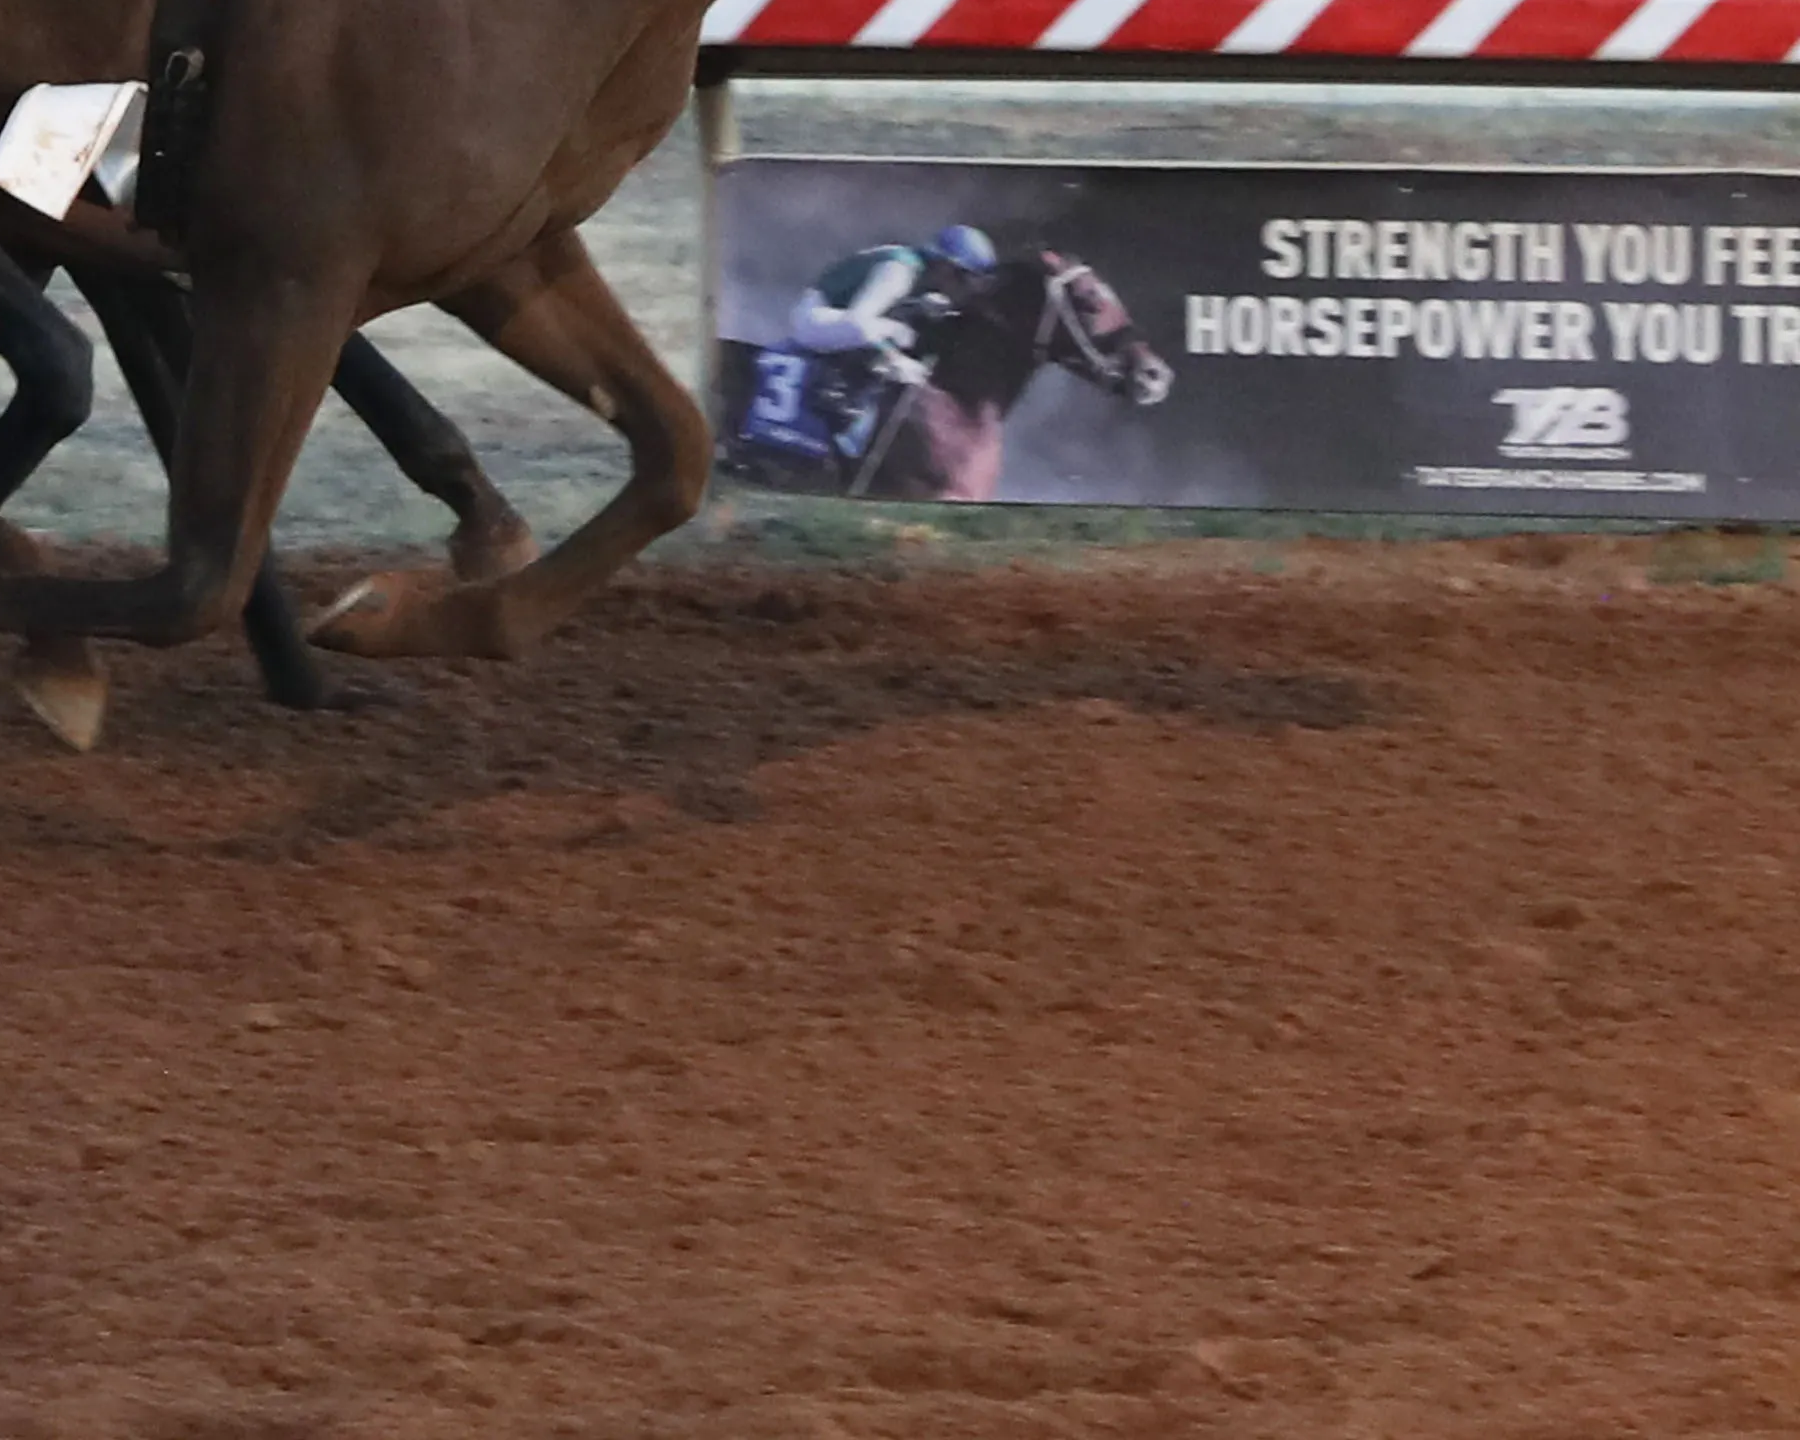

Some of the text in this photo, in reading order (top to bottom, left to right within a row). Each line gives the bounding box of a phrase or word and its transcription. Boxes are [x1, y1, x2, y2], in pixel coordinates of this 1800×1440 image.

[1260, 217, 1564, 284] STRENGTH
[1571, 223, 1694, 285] YOU
[1185, 293, 1597, 361] HORSEPOWER
[1602, 302, 1724, 364] YOU
[753, 351, 806, 423] 3
